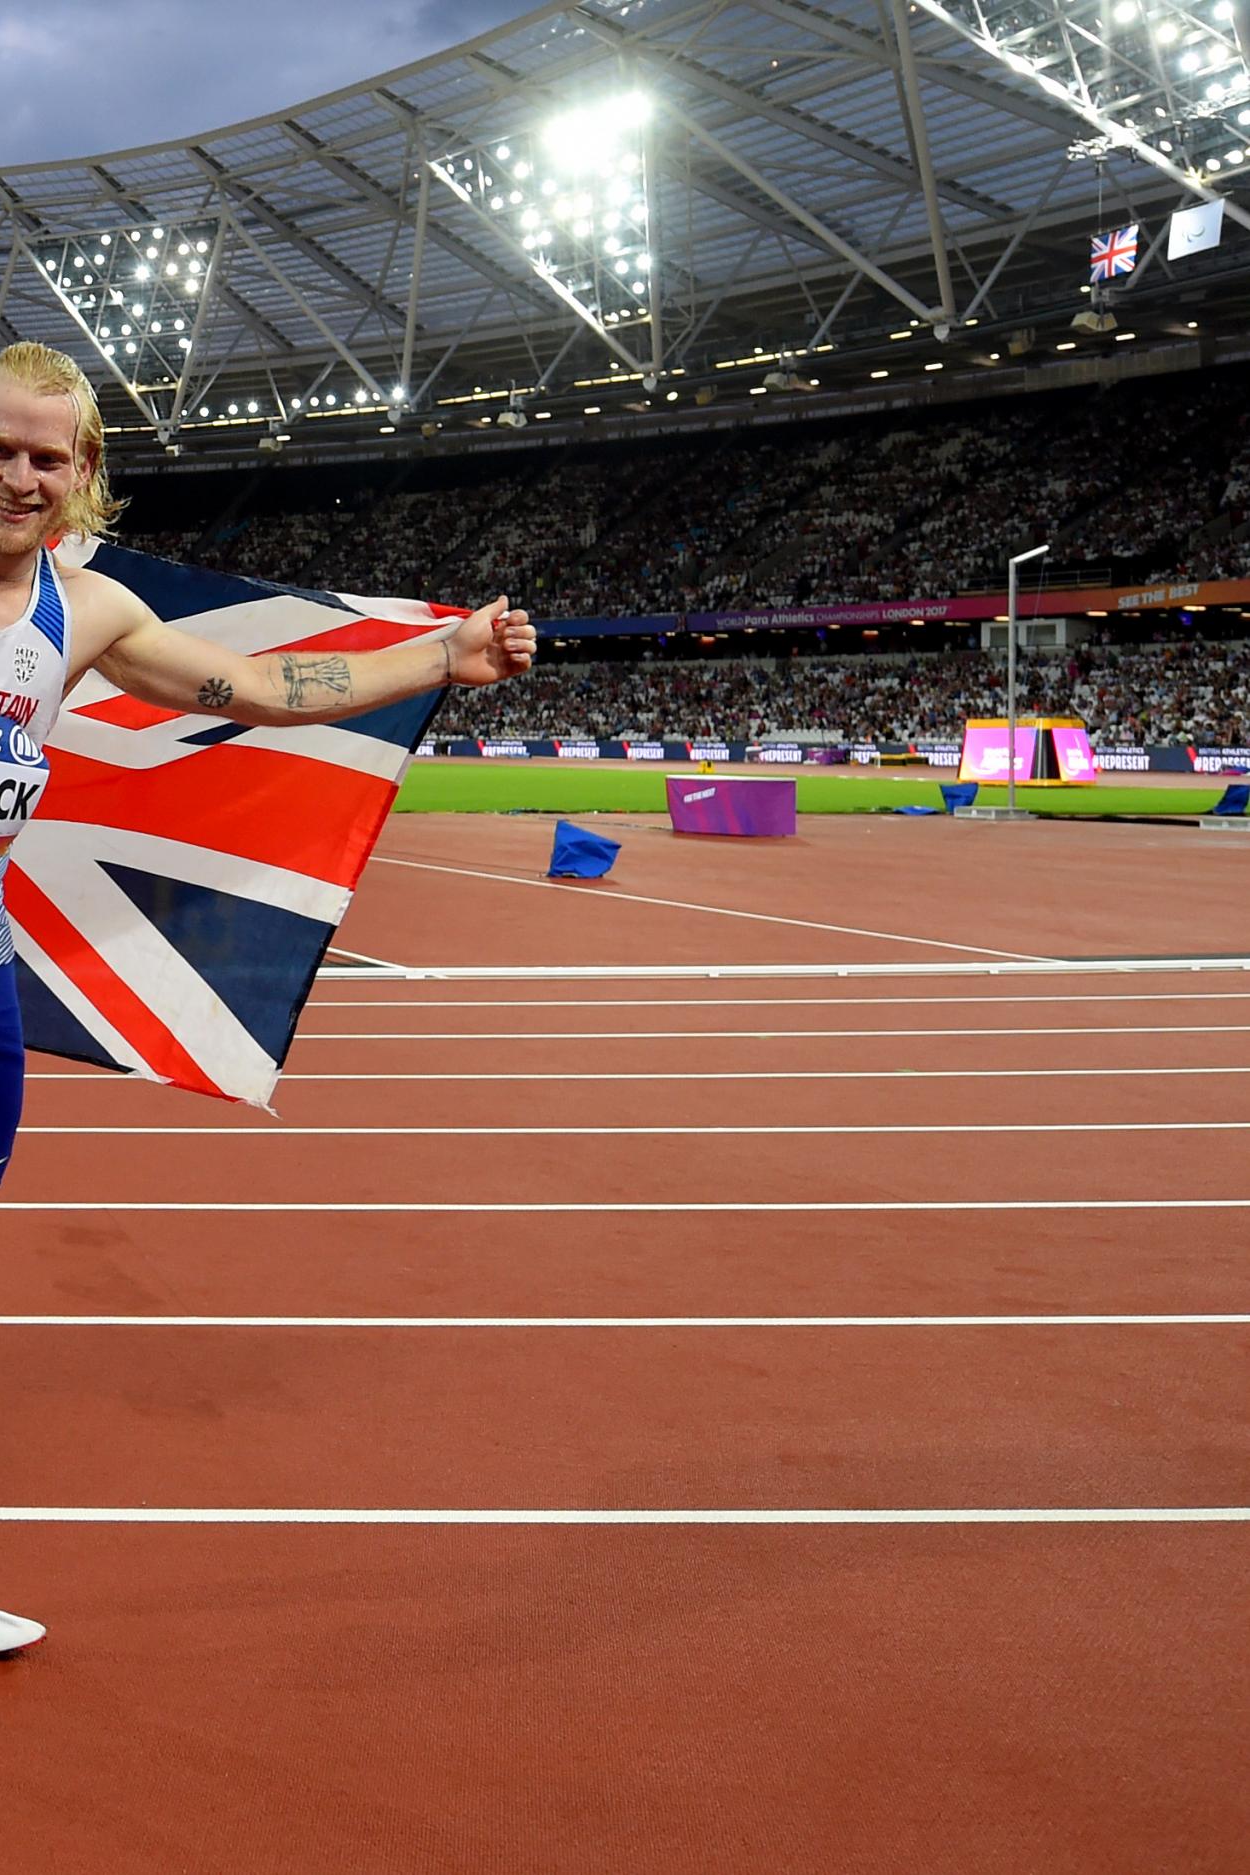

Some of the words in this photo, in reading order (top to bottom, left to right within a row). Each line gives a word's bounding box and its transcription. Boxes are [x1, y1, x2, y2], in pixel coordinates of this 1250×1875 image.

[1117, 595, 1140, 609] SEE
[1141, 590, 1166, 605] THE
[745, 615, 768, 625] Para
[771, 612, 814, 624] Athletics
[882, 608, 924, 619] LONDON
[925, 606, 947, 616] 2017
[1093, 755, 1149, 771] #REPRESENT
